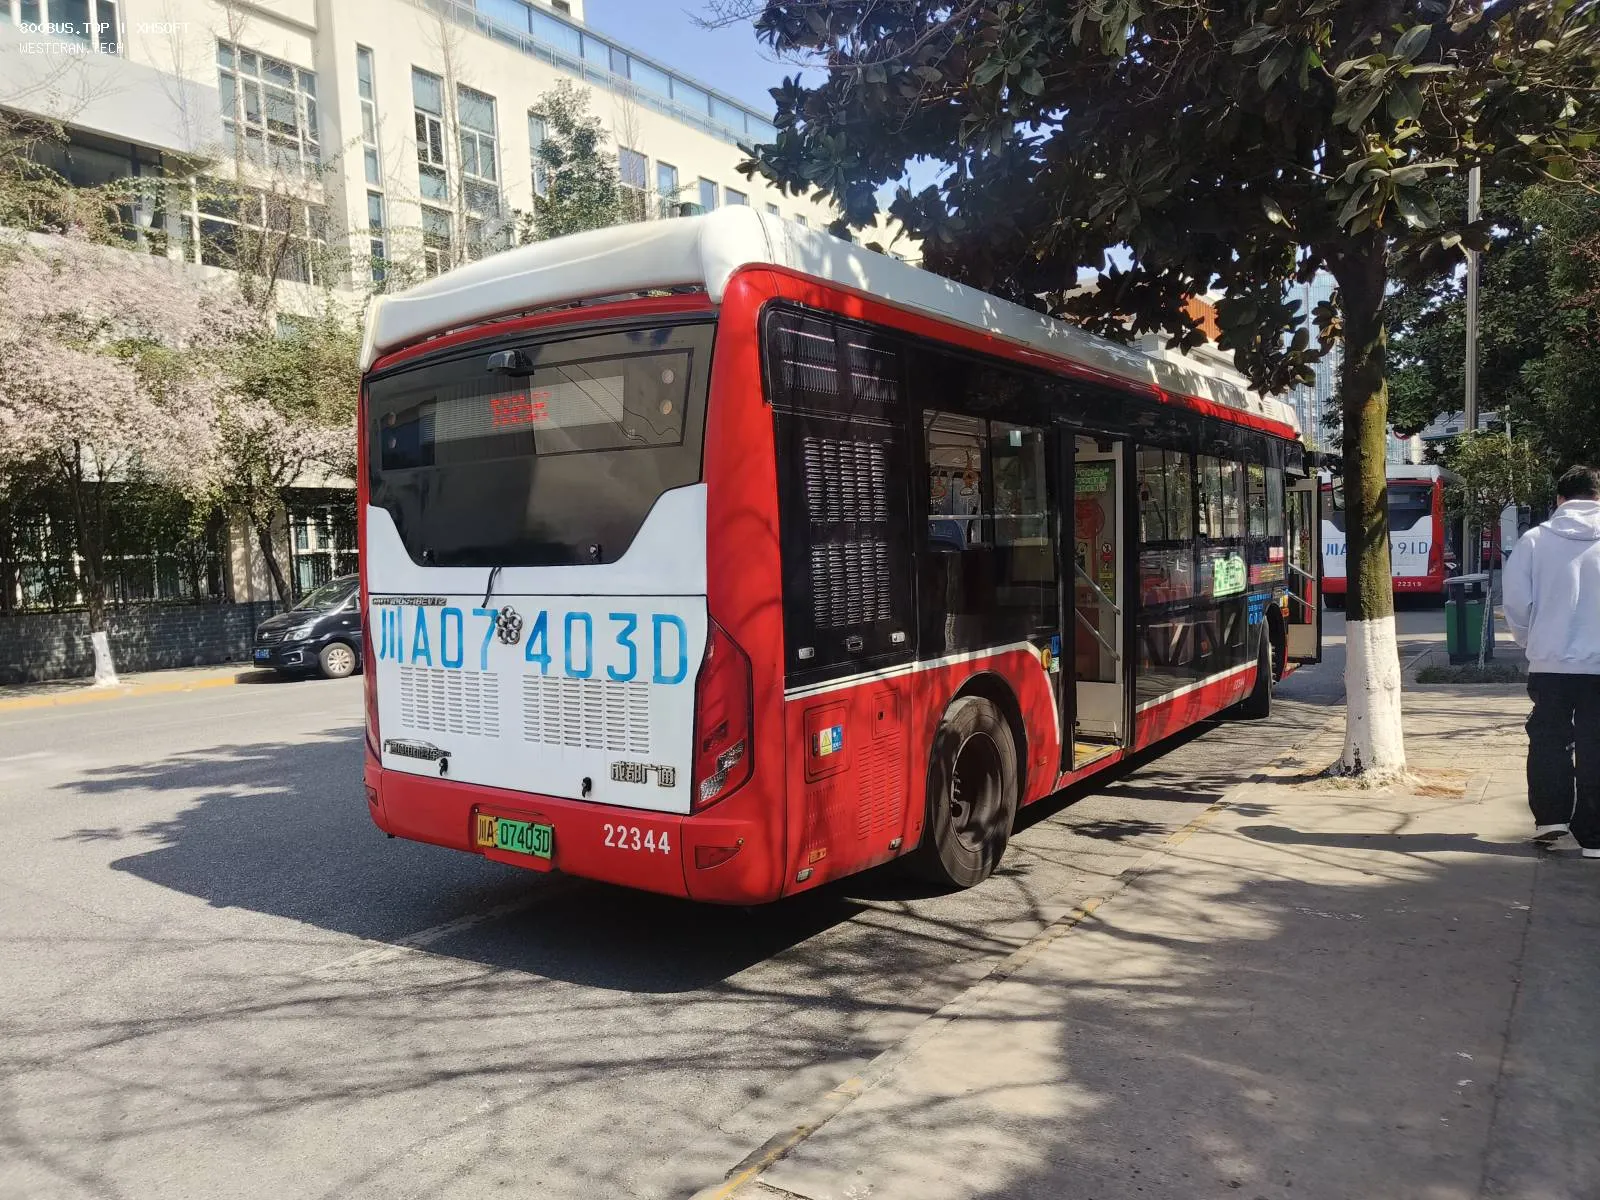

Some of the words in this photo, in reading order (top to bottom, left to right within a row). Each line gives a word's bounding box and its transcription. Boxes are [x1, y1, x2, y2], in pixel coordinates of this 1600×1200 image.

[609, 760, 677, 788] 成都广通
[603, 823, 671, 855] 22344
